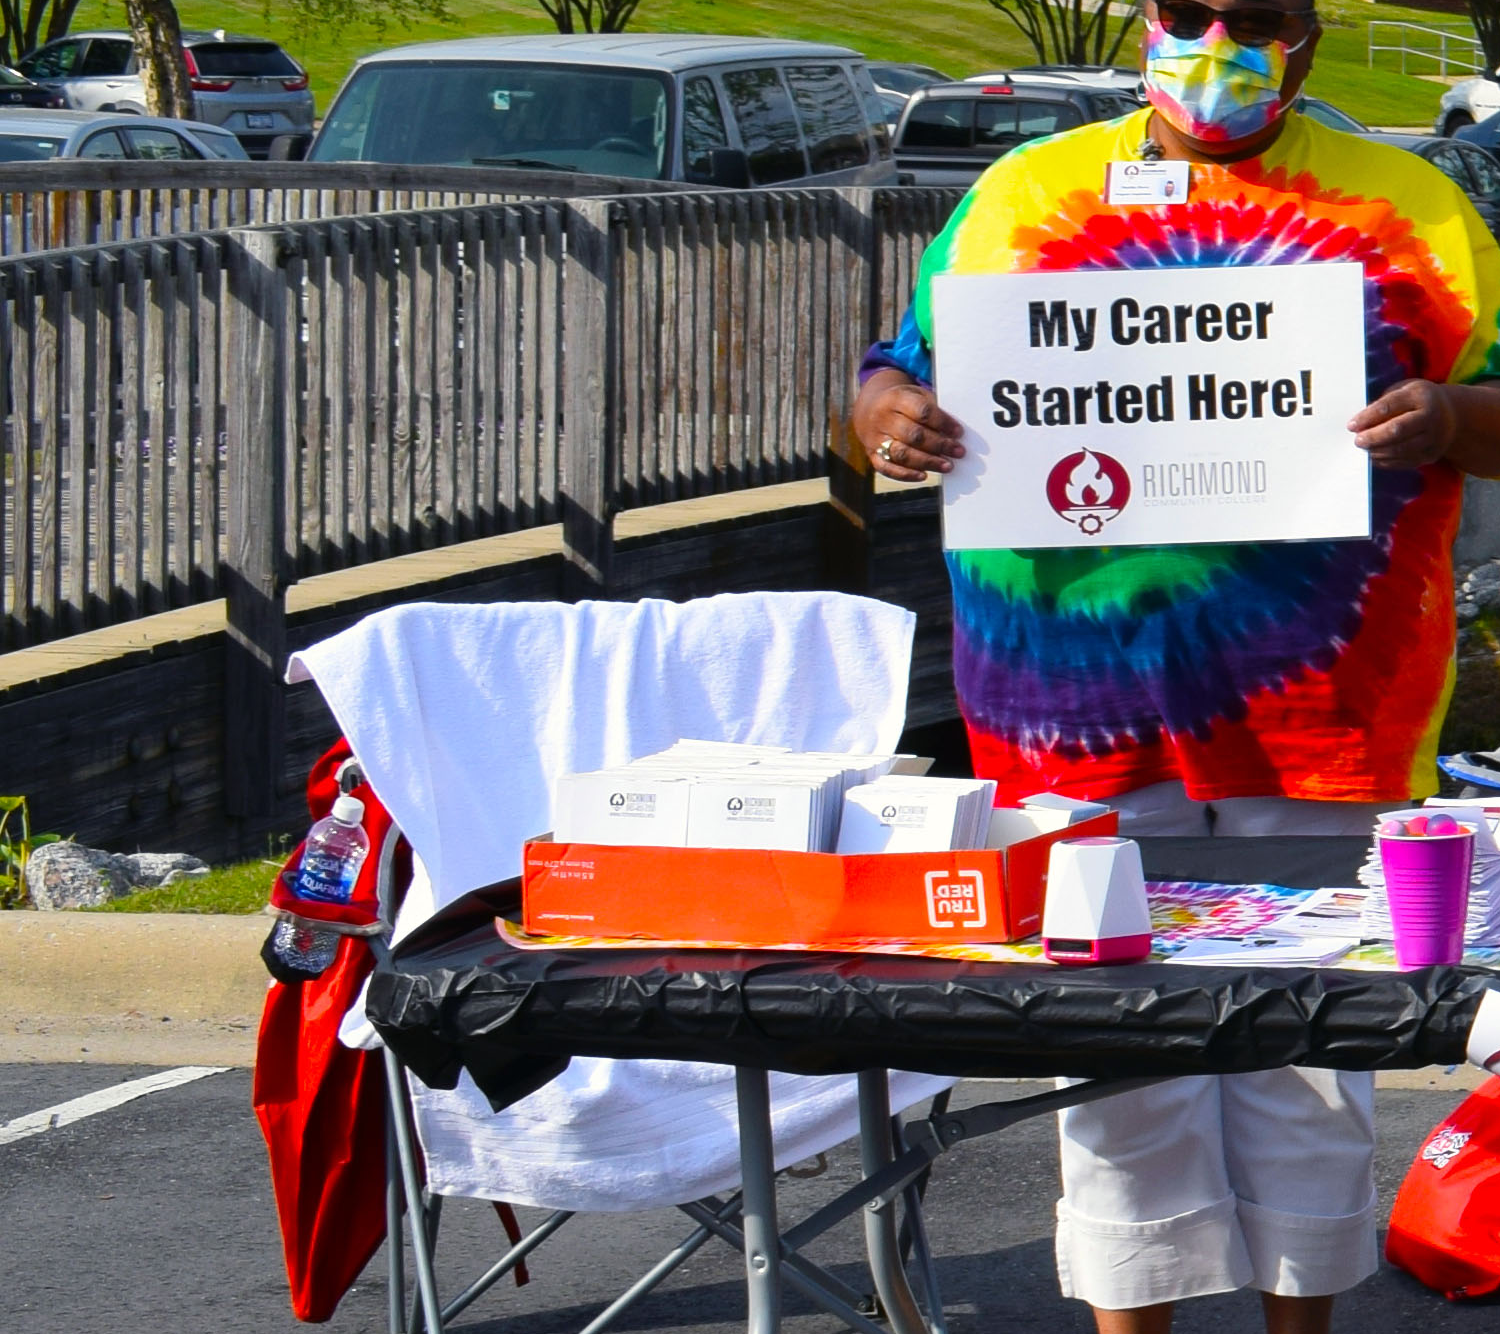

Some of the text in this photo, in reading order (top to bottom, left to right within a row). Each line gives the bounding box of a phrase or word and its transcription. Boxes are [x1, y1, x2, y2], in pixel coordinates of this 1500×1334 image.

[1029, 298, 1273, 351] My Career
[992, 371, 1313, 428] Started Here!
[1143, 460, 1267, 498] RICHMOND
[1143, 495, 1267, 507] COMMUNITY COLLEGE
[936, 884, 974, 898] RED
[938, 899, 976, 914] TRU
